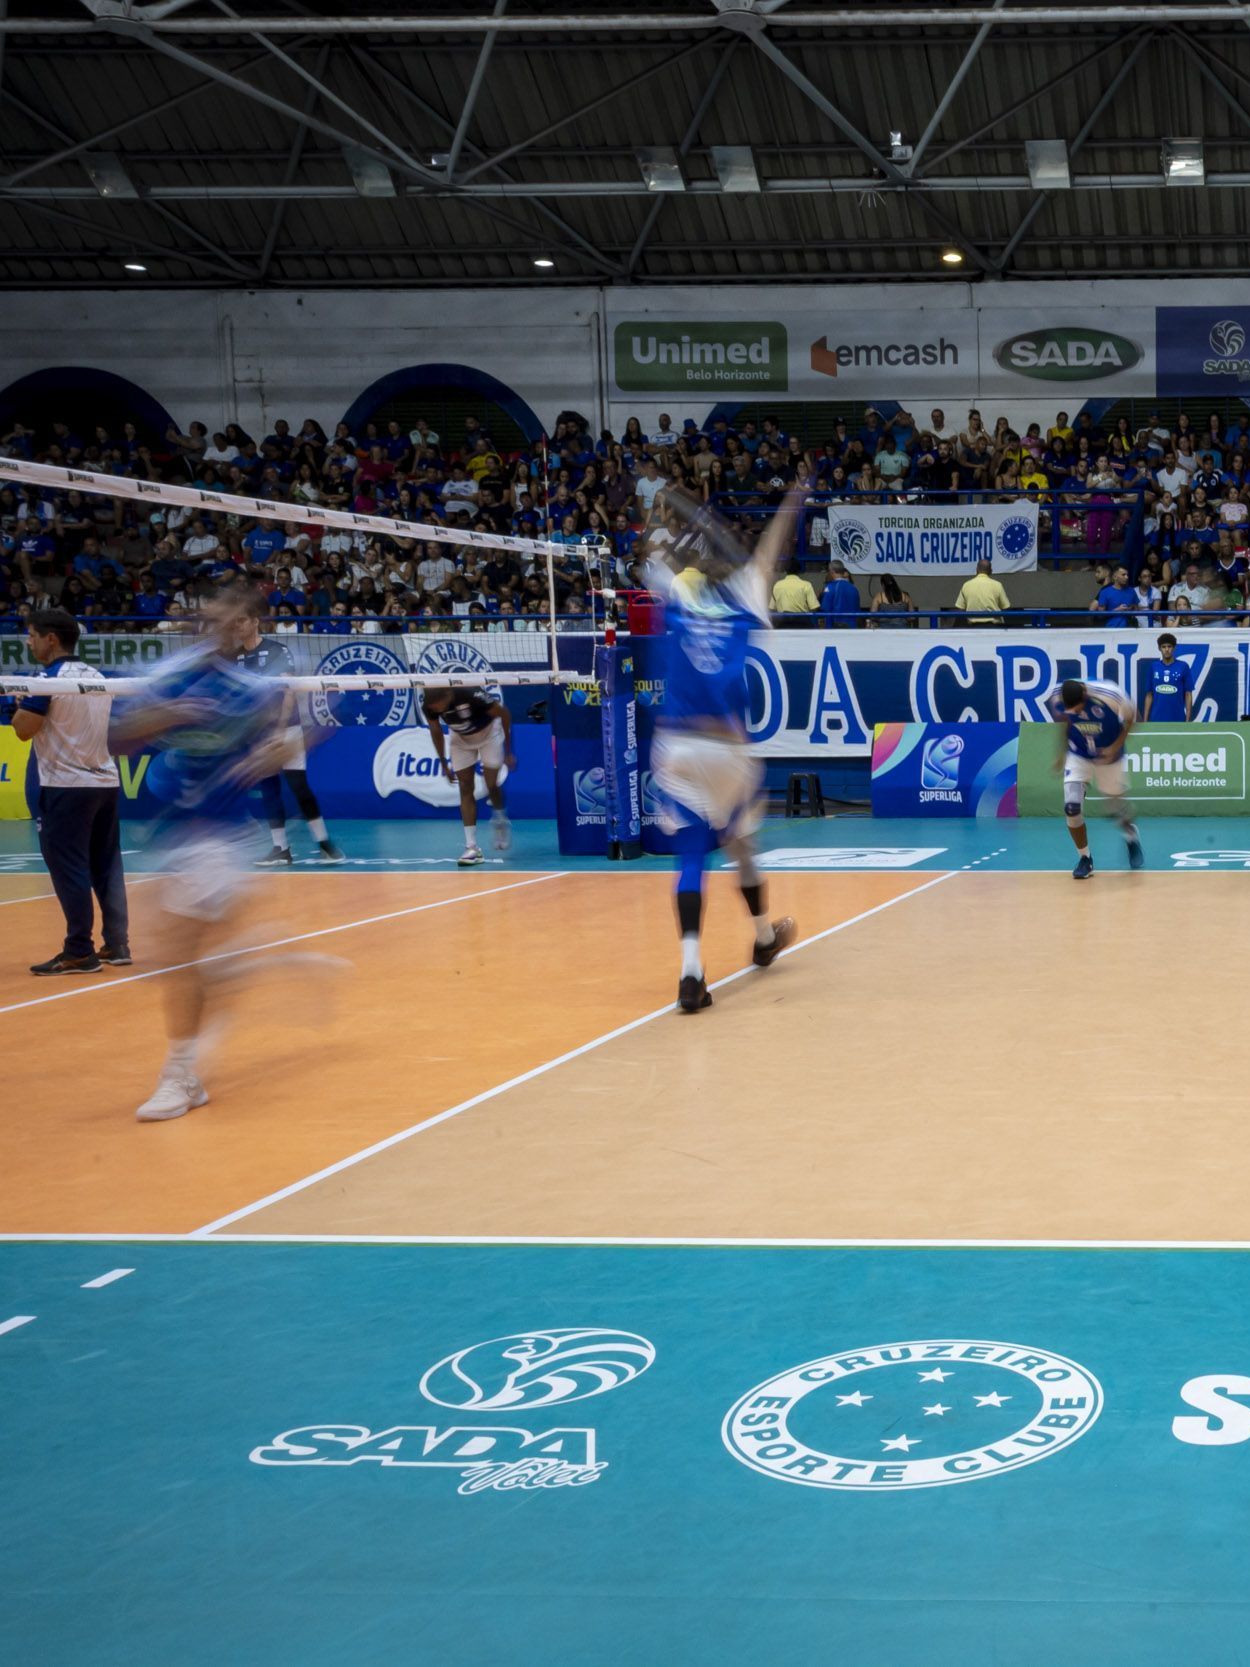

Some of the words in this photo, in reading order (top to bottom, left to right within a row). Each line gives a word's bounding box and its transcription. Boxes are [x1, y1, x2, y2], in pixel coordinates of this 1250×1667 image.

[631, 336, 770, 365] Unimed
[836, 338, 959, 366] emcash
[1010, 341, 1123, 367] SADA
[686, 369, 711, 381] Belo
[713, 369, 770, 381] Horizonte
[878, 517, 920, 529] TORCIDA
[923, 516, 985, 529] ORGANIZADA
[875, 532, 915, 563] SADA
[920, 531, 993, 563] CRUZEIRO
[626, 700, 638, 750] SUPERLIGA
[1124, 747, 1227, 772] nimed
[631, 769, 640, 820] SUPERLIGA
[919, 790, 962, 803] SUPERLIGA
[1146, 777, 1170, 787] Belo
[1173, 777, 1227, 787] Horizonte
[799, 1344, 1072, 1383] CRUZEIRO
[249, 1424, 596, 1467] SADA
[741, 1396, 908, 1483] ESPORTE
[943, 1396, 1087, 1475] CLUBE
